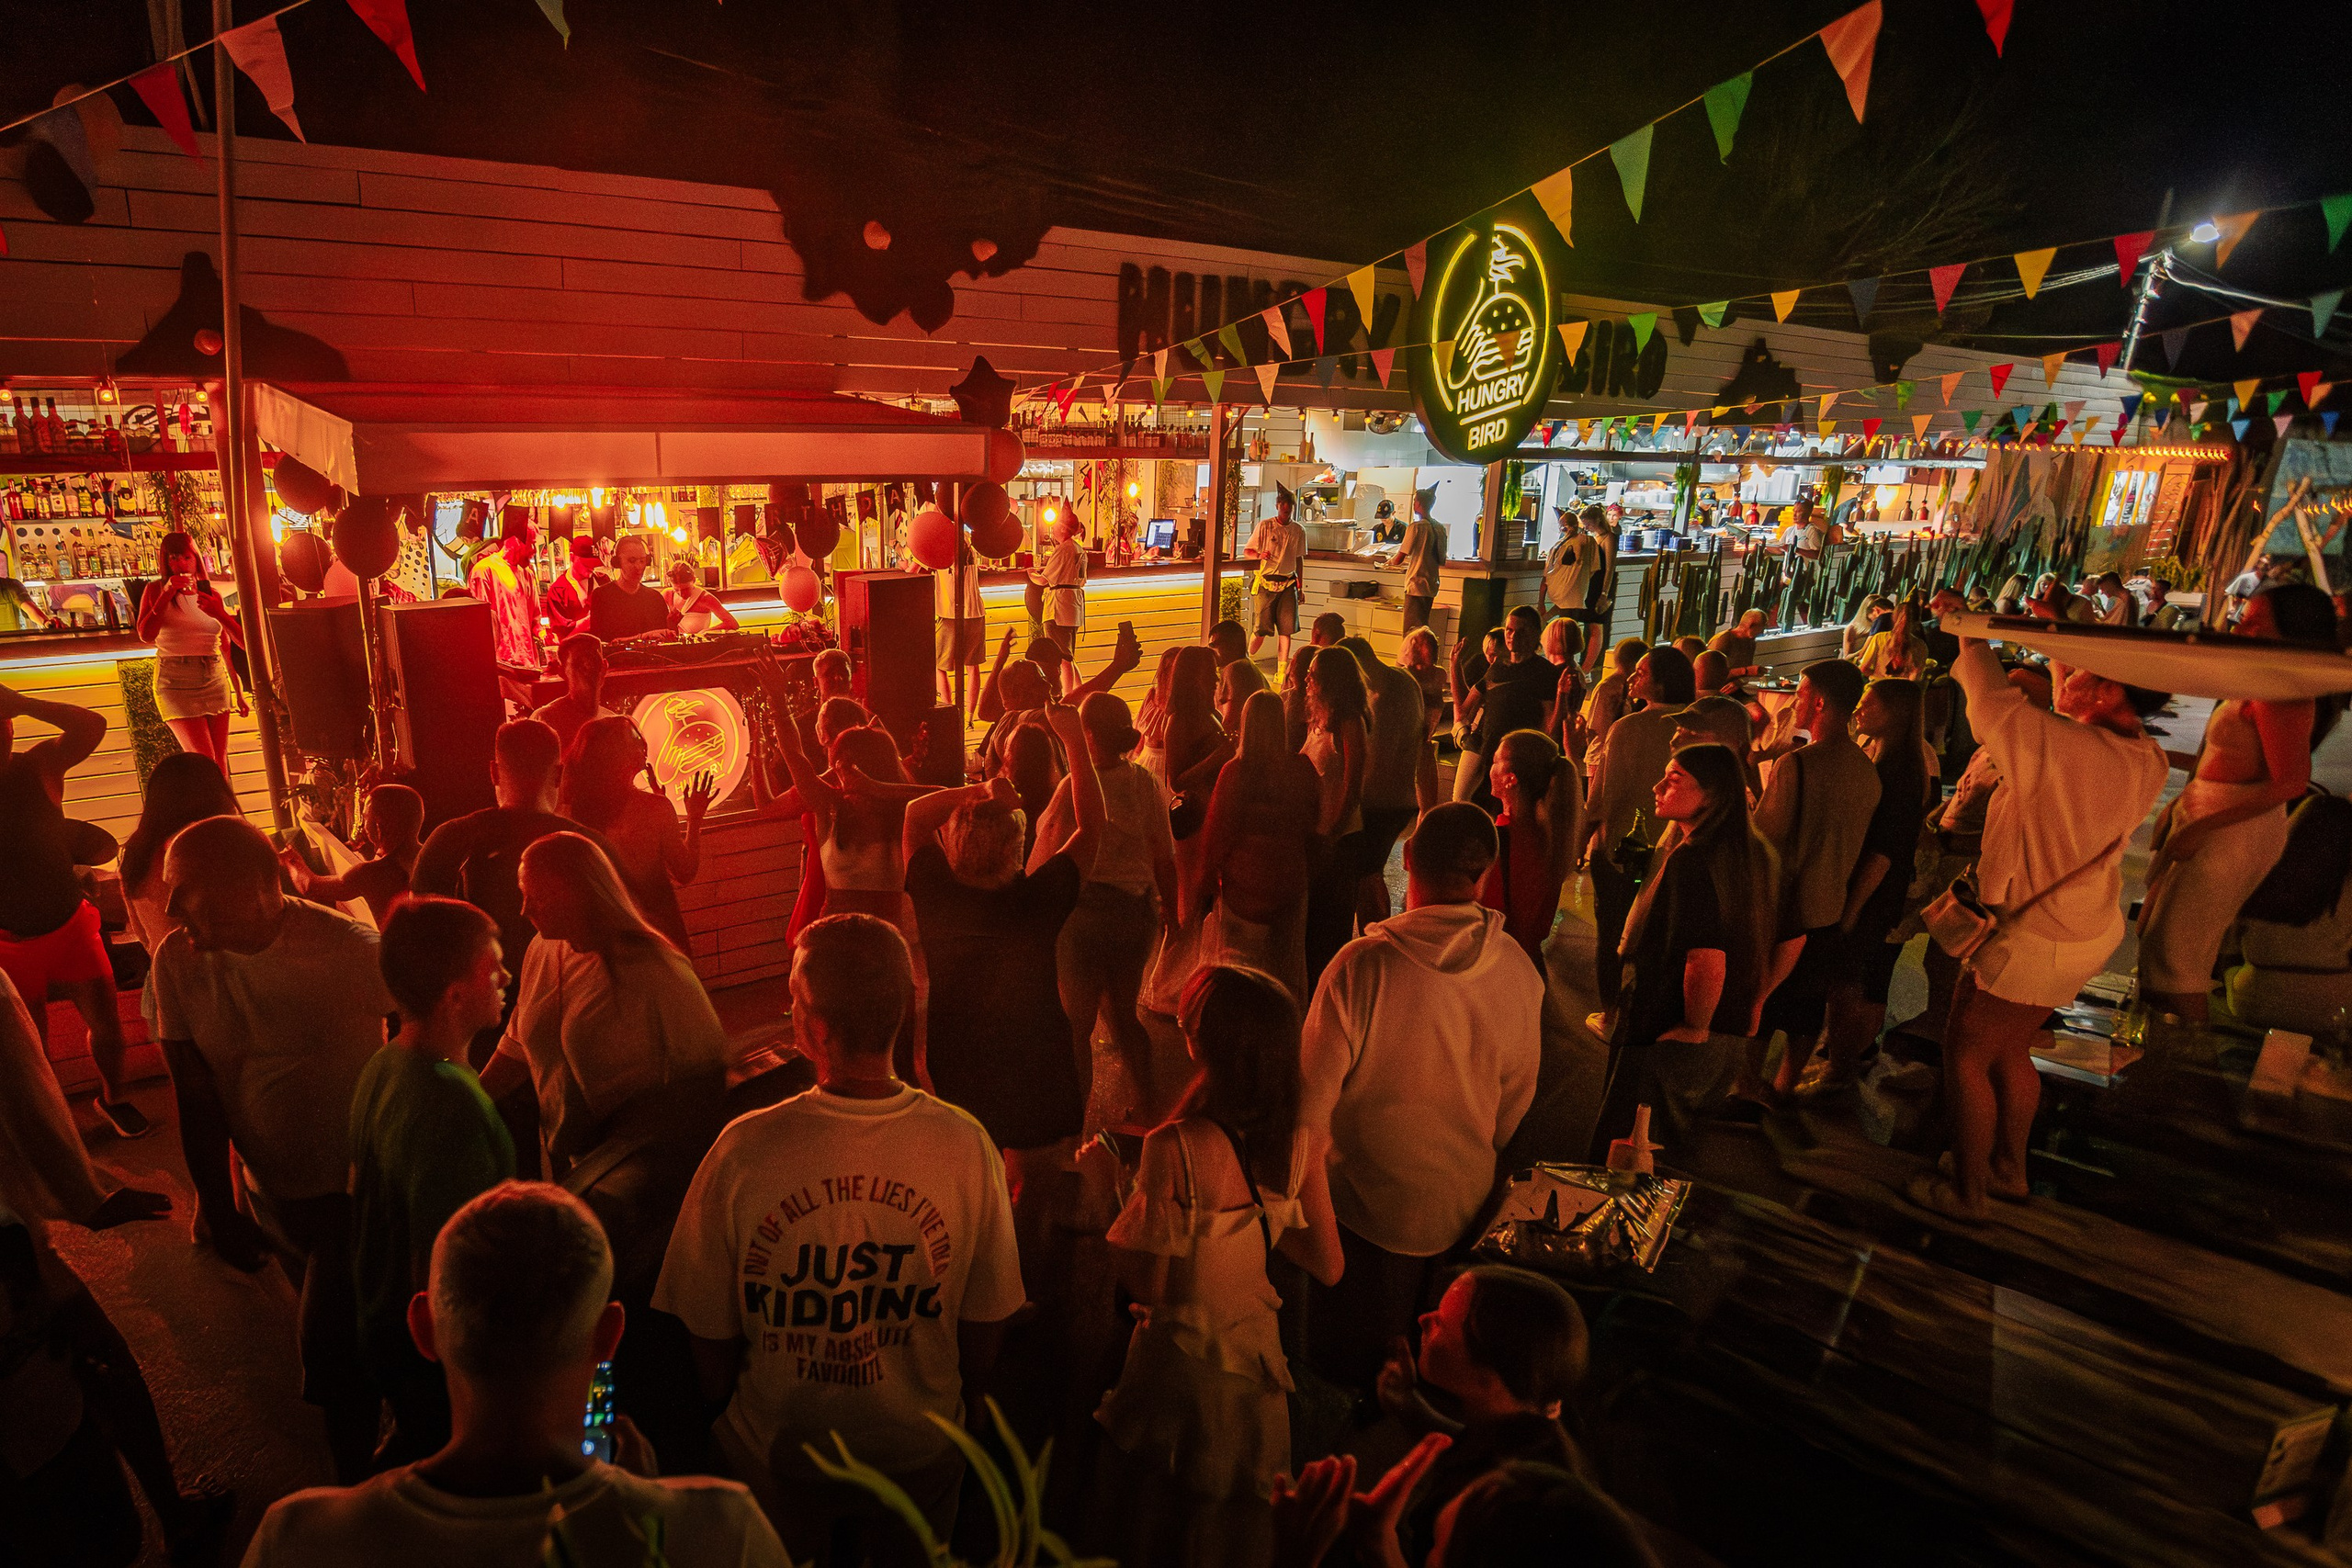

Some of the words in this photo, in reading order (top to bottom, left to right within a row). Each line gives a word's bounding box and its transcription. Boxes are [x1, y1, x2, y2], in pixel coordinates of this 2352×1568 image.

[1116, 261, 1402, 380] HUNGRY
[1558, 314, 1668, 400] BIRD
[1456, 370, 1530, 415] HUNGRY
[1467, 417, 1508, 451] BIRD
[757, 1214, 784, 1244] OF
[780, 1187, 820, 1224] ALL
[821, 1175, 865, 1204] THE
[869, 1176, 916, 1213] LIES
[780, 1241, 916, 1288] JUST
[744, 1281, 943, 1333] KIDDING
[786, 1332, 817, 1356] MY
